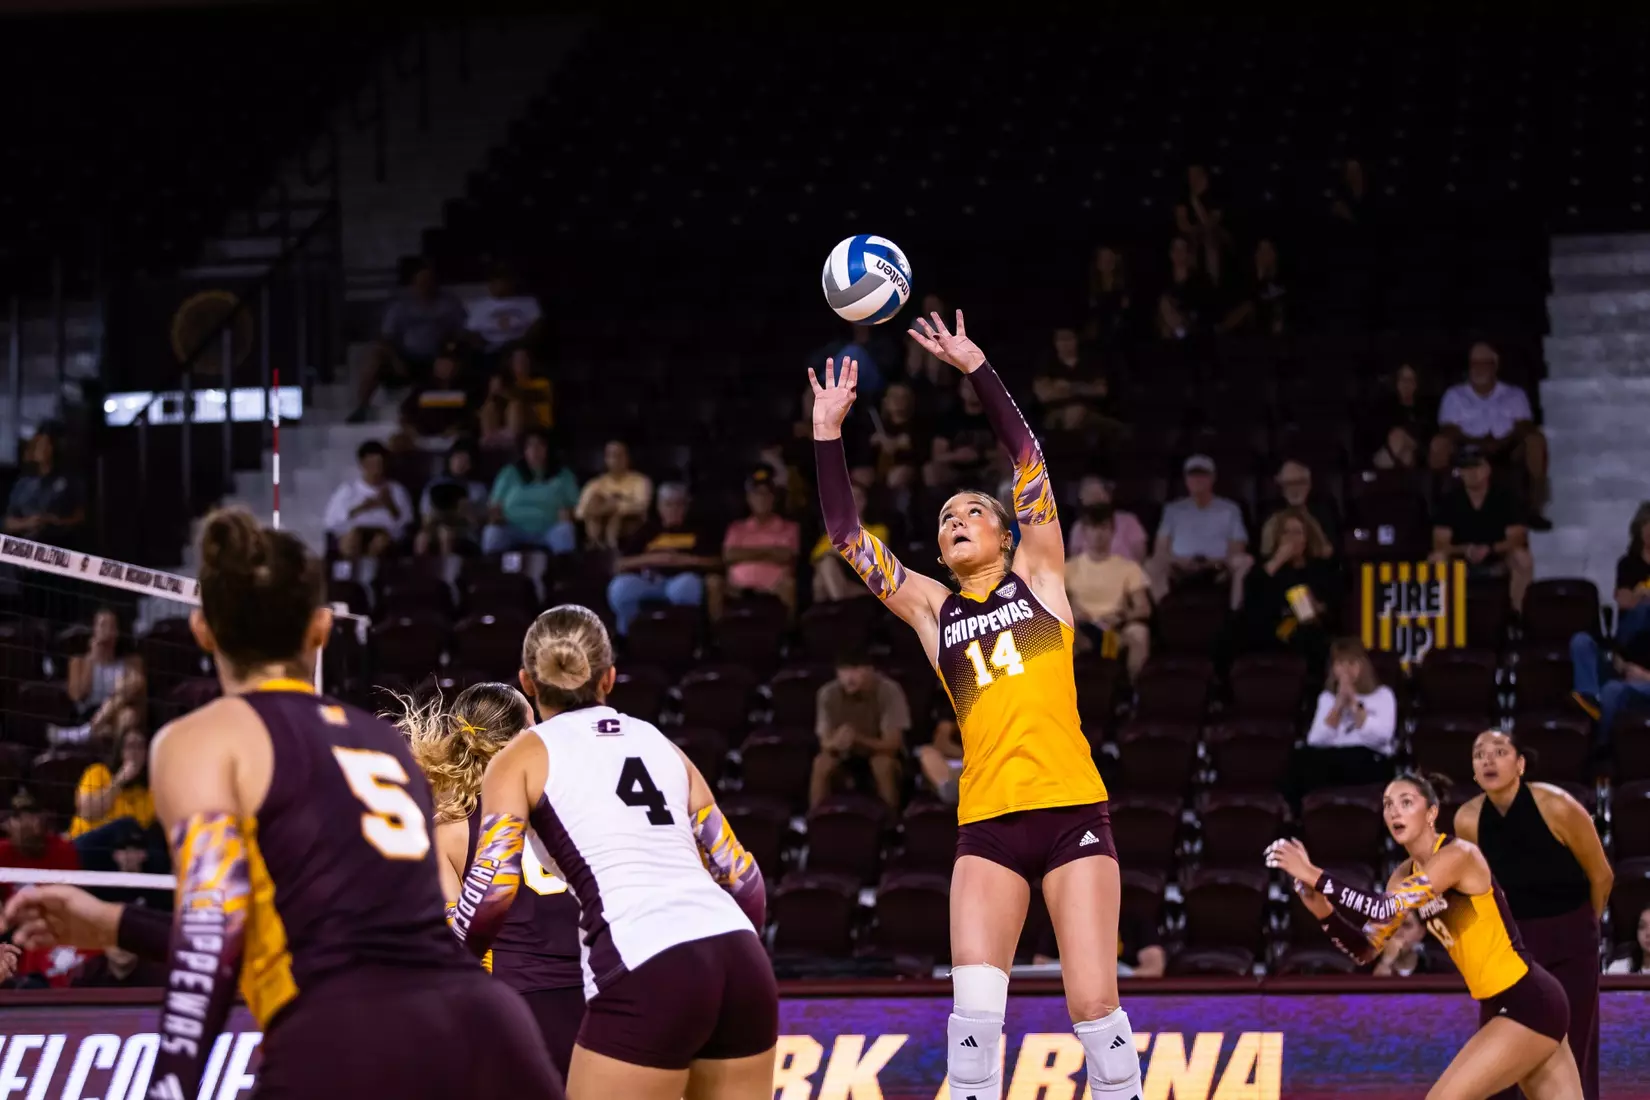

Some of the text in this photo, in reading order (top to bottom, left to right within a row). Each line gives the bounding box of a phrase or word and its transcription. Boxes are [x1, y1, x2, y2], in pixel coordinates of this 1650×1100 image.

[876, 260, 909, 296] molten
[944, 599, 1034, 649] CHIPPEWAS
[1378, 580, 1446, 618] FIRE
[964, 629, 1025, 687] 14
[331, 745, 431, 860] 5
[615, 757, 676, 826] 4
[1339, 887, 1404, 920] CHIPPEWAS
[160, 887, 226, 1059] CHIPPEWAS
